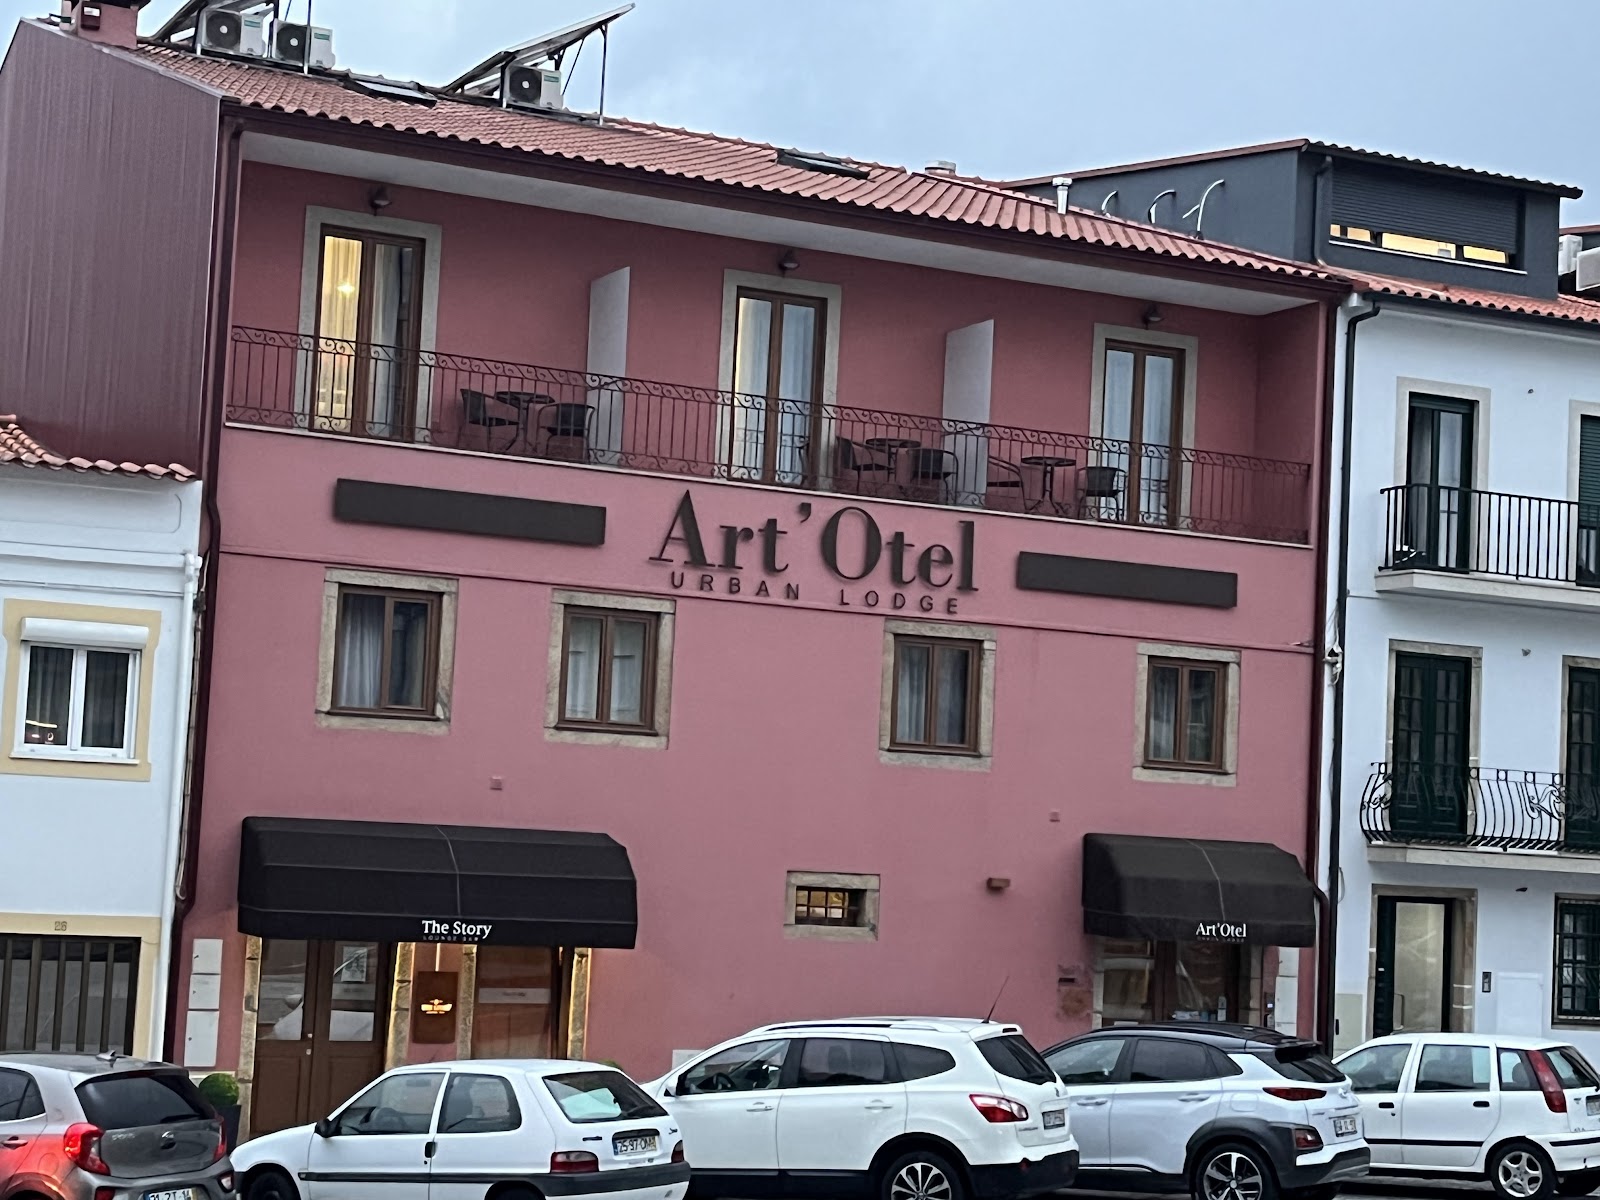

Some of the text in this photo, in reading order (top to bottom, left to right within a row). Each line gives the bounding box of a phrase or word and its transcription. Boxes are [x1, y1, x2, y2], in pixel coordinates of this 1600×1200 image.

[670, 570, 959, 615] URBAN LODGE
[54, 920, 67, 932] 26
[421, 919, 493, 939] The Story
